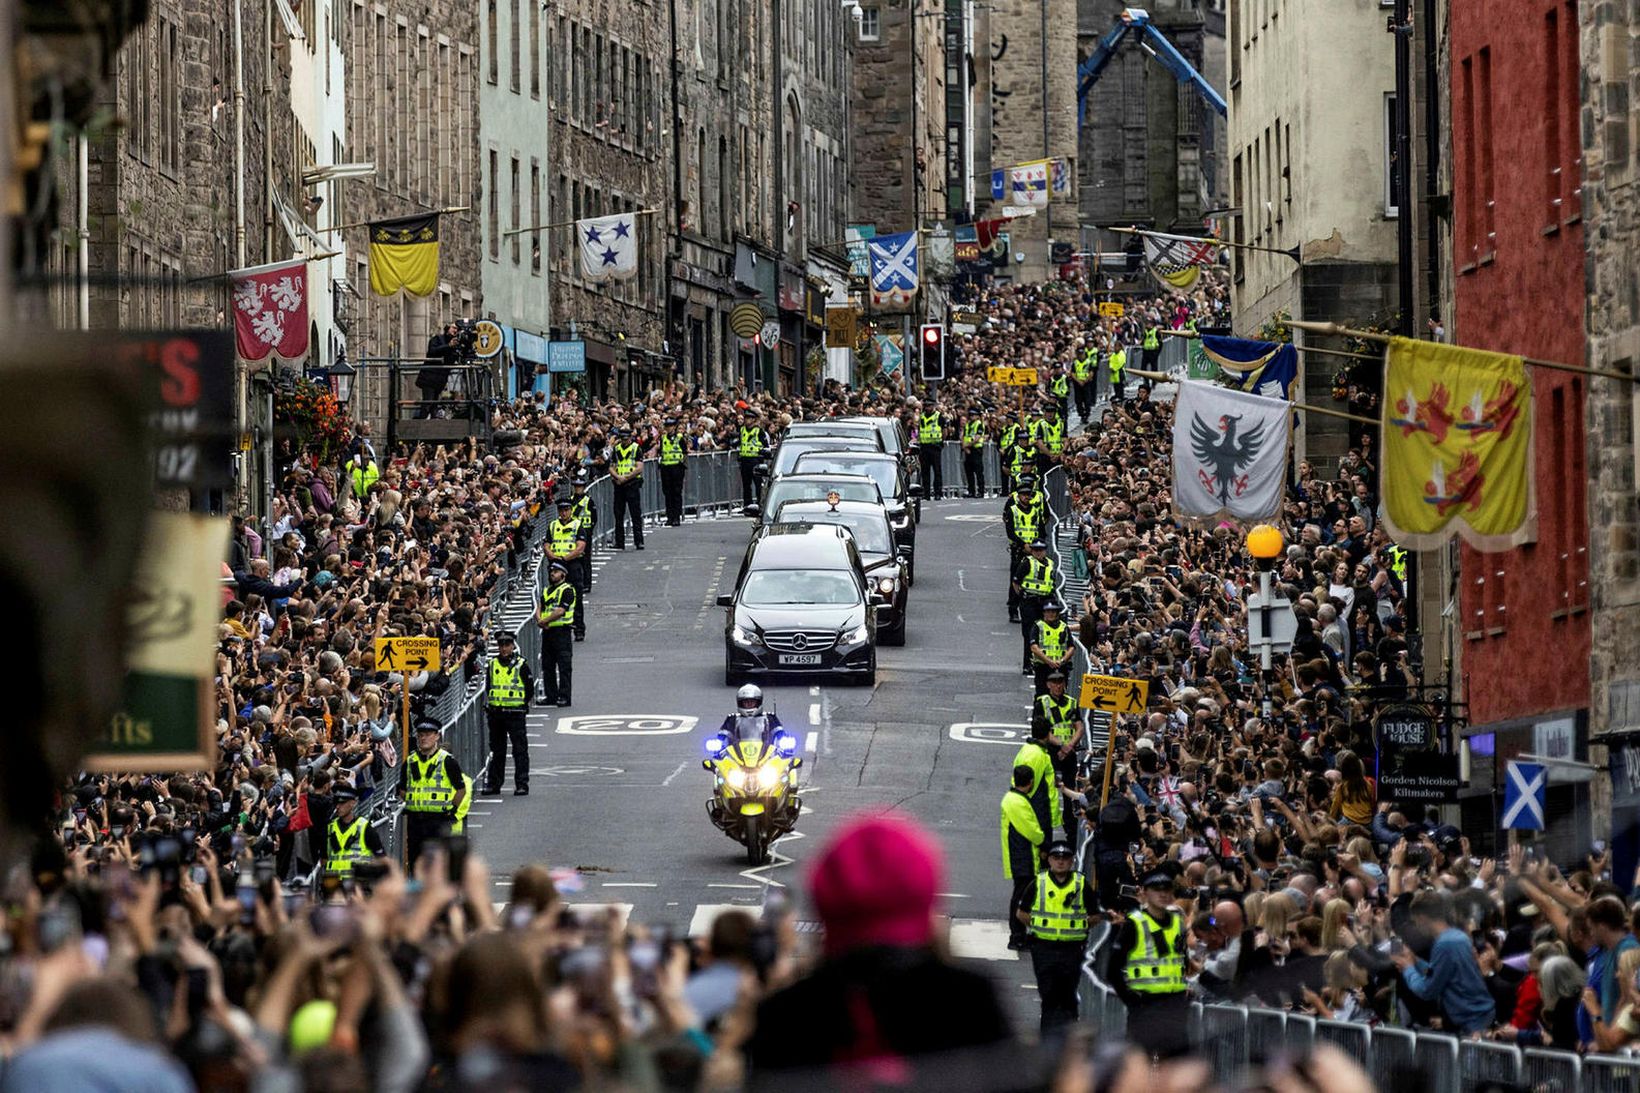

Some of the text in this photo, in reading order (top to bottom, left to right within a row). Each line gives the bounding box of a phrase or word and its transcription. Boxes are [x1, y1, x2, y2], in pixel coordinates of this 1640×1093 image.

[955, 245, 979, 257] afe
[796, 655, 816, 663] 4597
[1084, 677, 1128, 688] CROSSING
[1093, 687, 1117, 696] POINT
[111, 712, 152, 744] fts
[577, 719, 675, 730] 20
[1383, 722, 1425, 735] FUDGE
[1381, 775, 1458, 786] Gordon Nicolson
[1394, 787, 1445, 798] Kiltmakers
